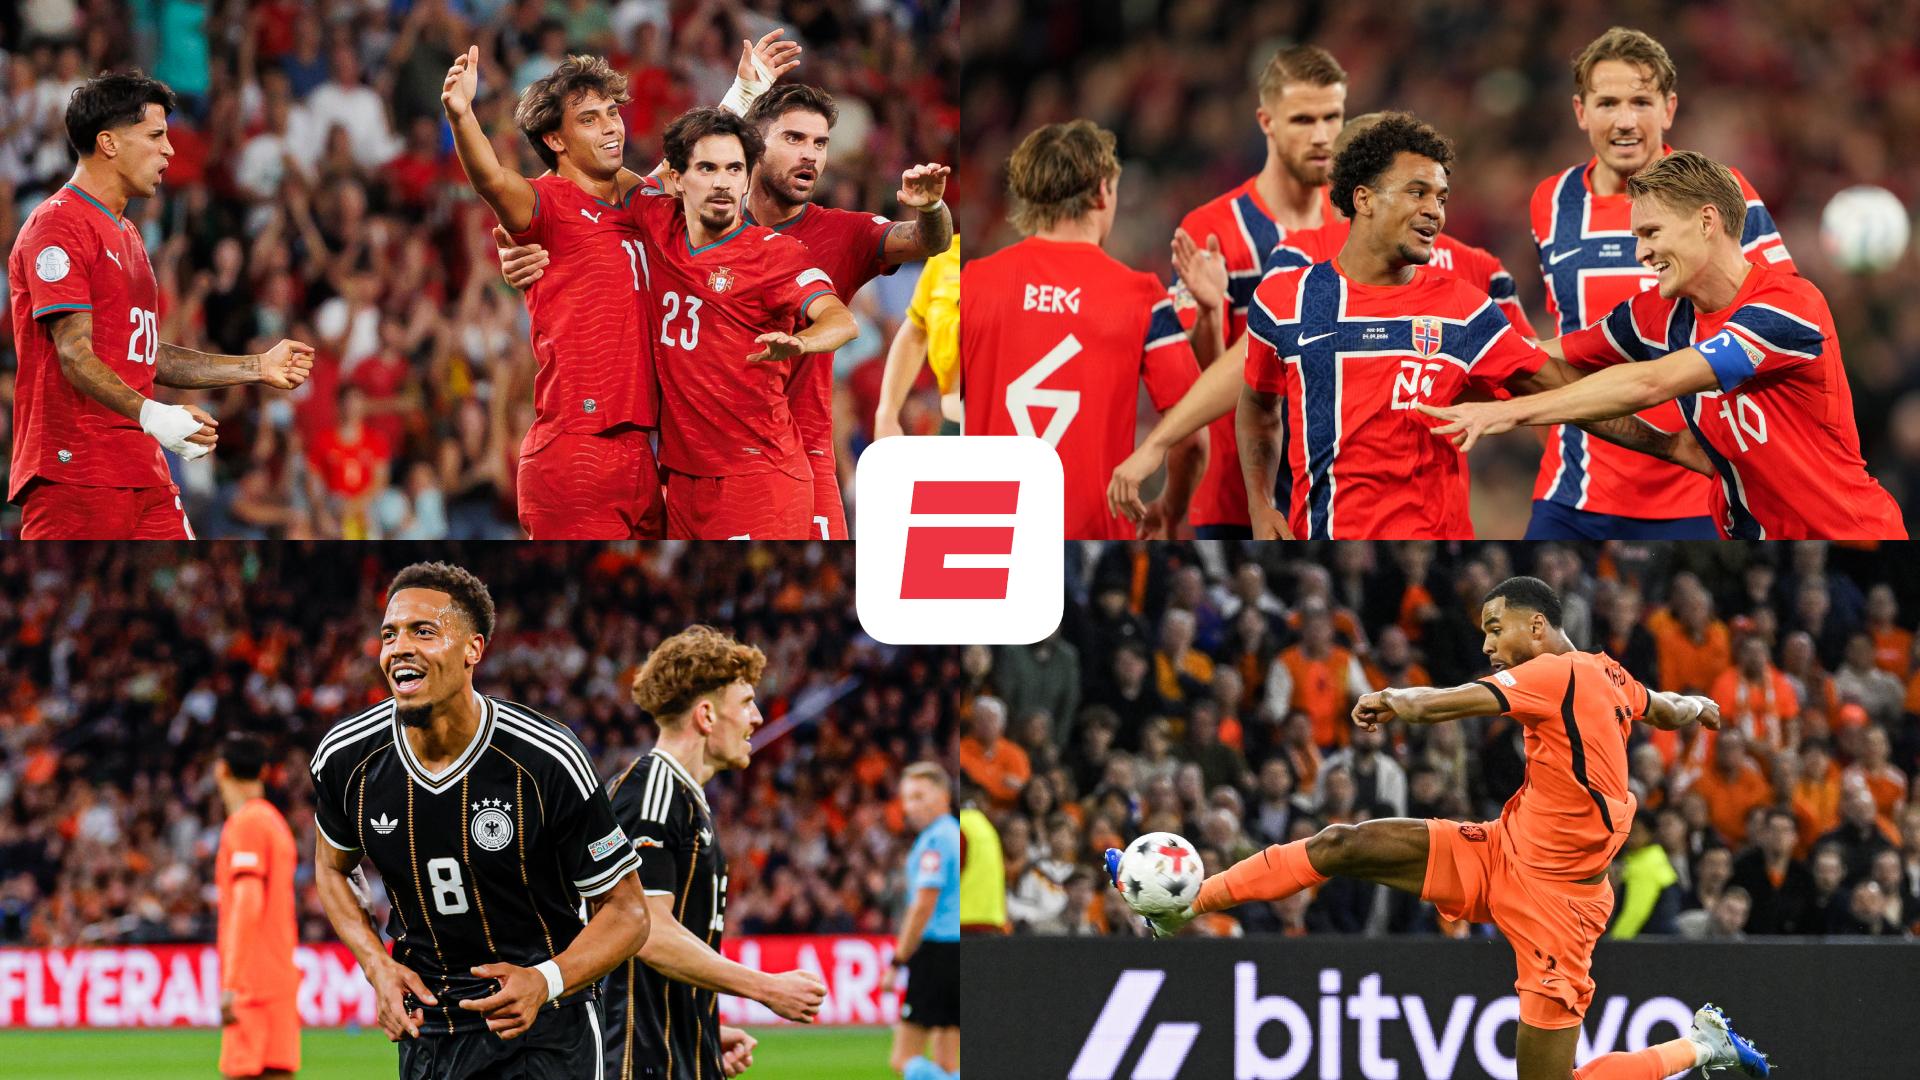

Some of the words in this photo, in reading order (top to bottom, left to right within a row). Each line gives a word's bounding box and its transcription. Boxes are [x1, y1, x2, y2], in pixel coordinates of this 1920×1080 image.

[622, 239, 650, 292] 11
[660, 291, 703, 350] 23
[1024, 283, 1081, 314] BERG
[127, 306, 159, 365] 20
[1699, 332, 1731, 354] C
[1005, 333, 1083, 451] 6
[1719, 393, 1768, 452] 10
[427, 857, 469, 915] 8
